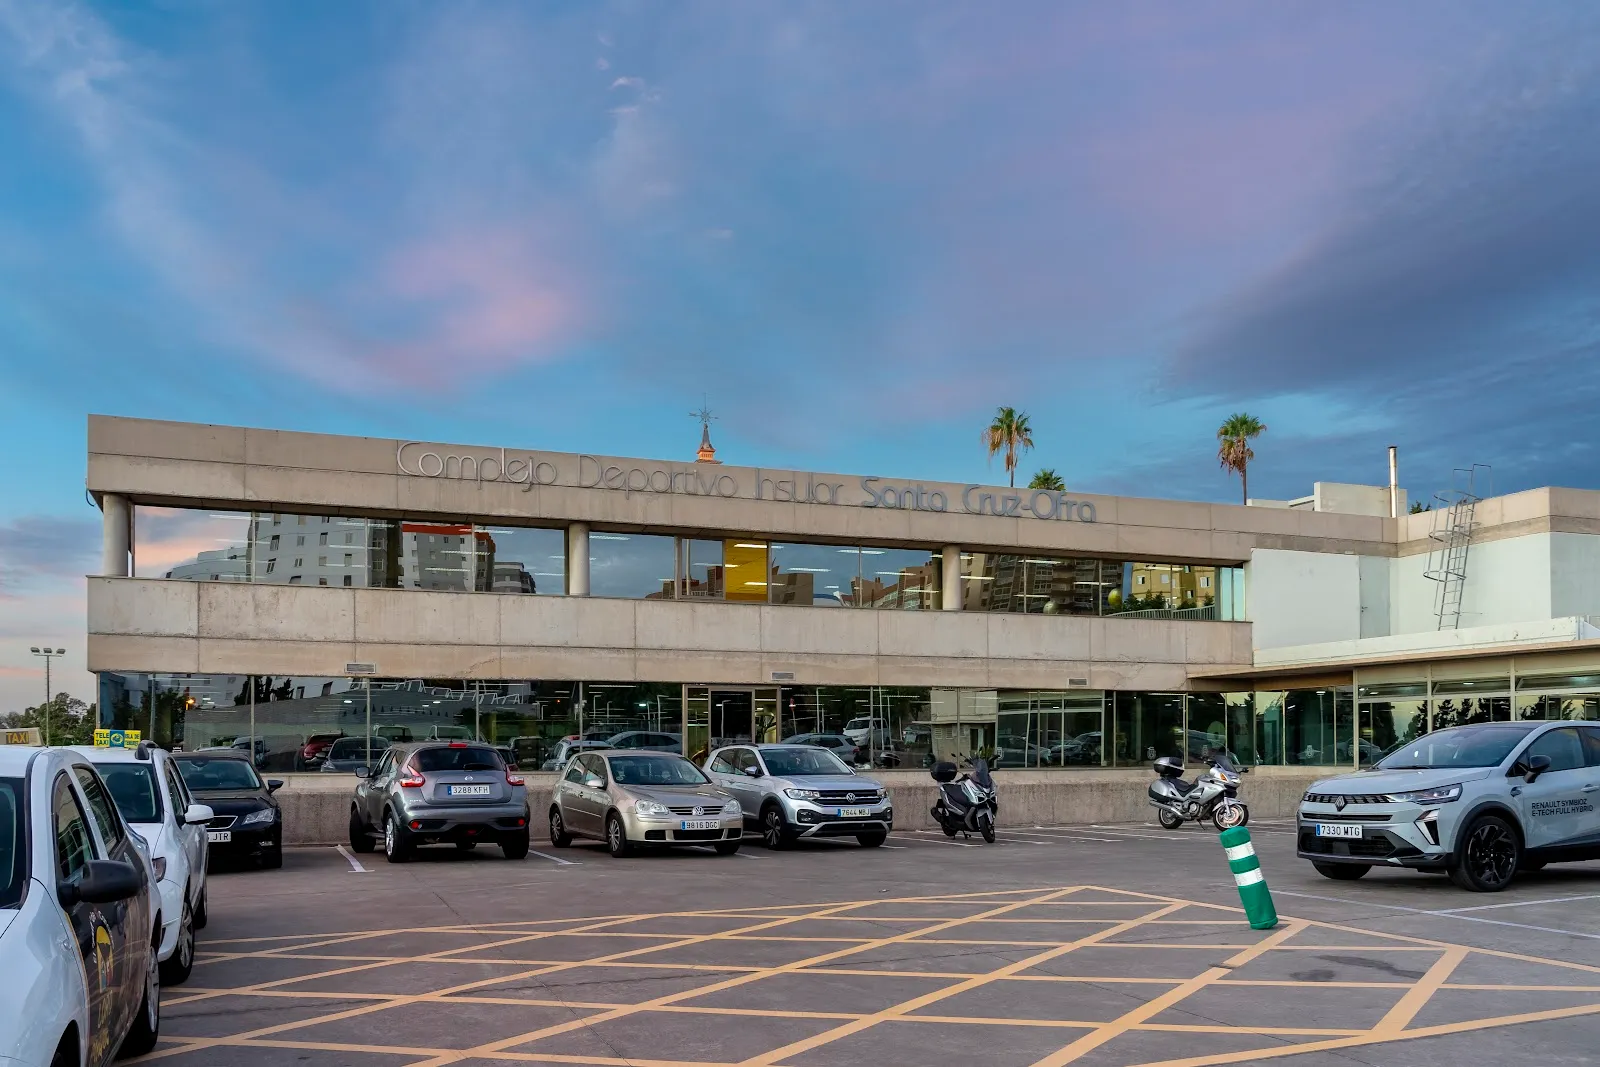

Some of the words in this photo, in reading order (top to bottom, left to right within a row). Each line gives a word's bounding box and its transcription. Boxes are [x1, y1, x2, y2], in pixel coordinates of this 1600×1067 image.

[397, 441, 558, 493] Complejo
[577, 454, 738, 500] Deportivo
[754, 467, 844, 504] Insular
[860, 475, 949, 513] Santa
[961, 483, 1097, 523] Cruz-Ofra
[7, 731, 30, 744] TAXI
[453, 786, 472, 794] 3288
[473, 786, 489, 794] KFH
[1531, 800, 1560, 810] RENAULT
[1561, 798, 1588, 807] SYMBIOZ
[1531, 808, 1555, 817] E-TECH
[1555, 807, 1571, 815] FULL
[1571, 804, 1594, 814] HYBRID
[686, 821, 704, 829] 9816
[705, 821, 718, 829] DGC
[1321, 825, 1341, 836] 7330
[1343, 826, 1360, 836] MTG
[212, 832, 229, 841] JTR
